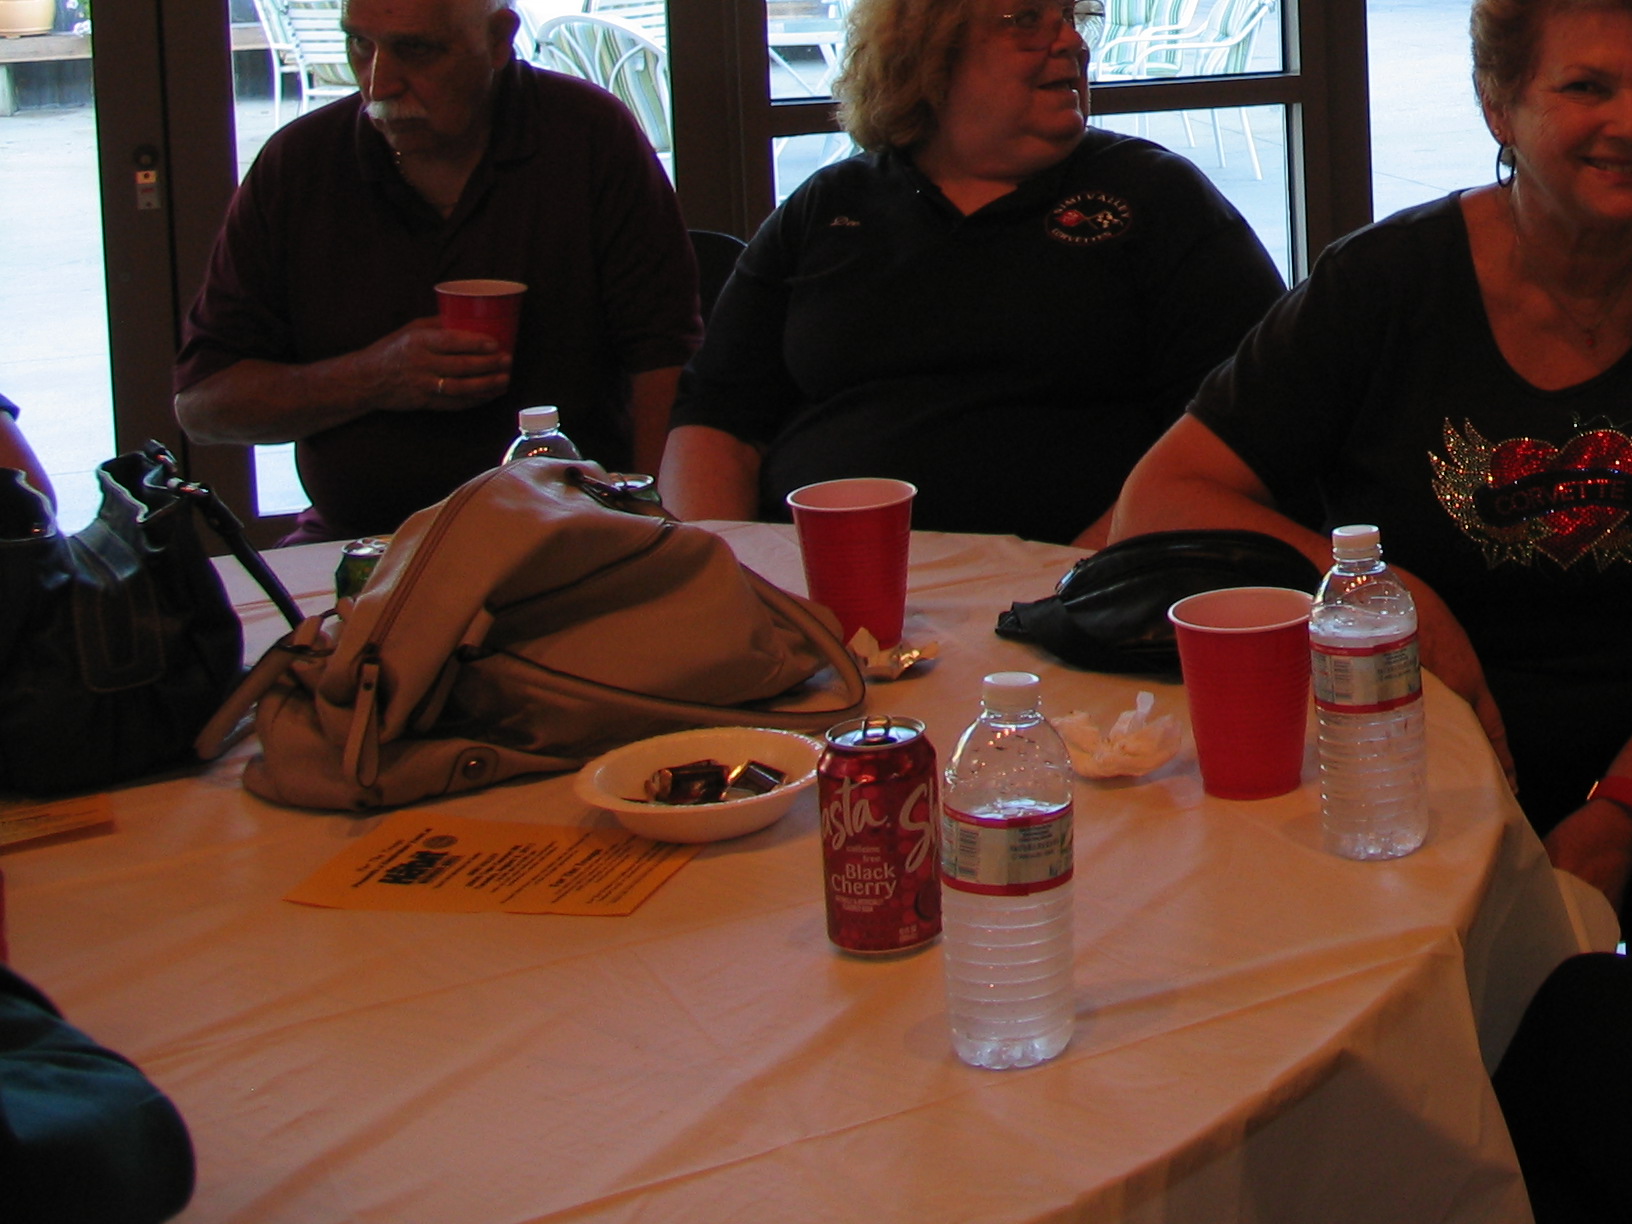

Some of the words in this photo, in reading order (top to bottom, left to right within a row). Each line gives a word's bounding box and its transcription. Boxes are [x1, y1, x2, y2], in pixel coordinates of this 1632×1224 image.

[1493, 478, 1628, 516] CORVETTE
[845, 862, 896, 880] Black
[831, 873, 897, 900] Cherry
